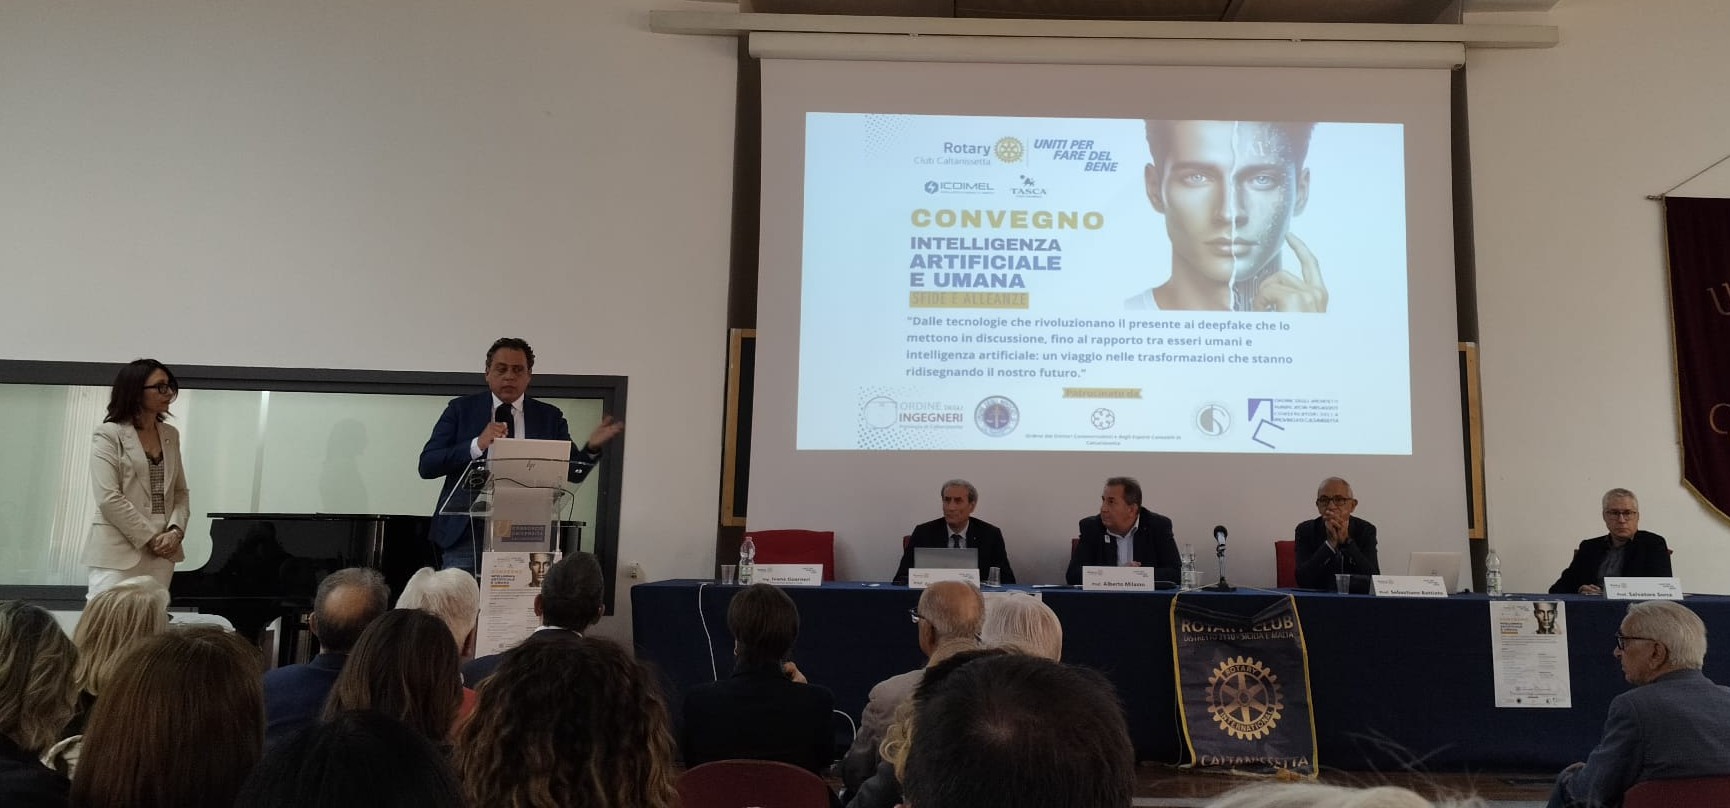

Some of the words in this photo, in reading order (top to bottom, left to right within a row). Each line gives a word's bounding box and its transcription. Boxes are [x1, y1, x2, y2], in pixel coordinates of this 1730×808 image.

[944, 142, 991, 157] Rotary
[1033, 139, 1067, 150] UNITI
[1070, 140, 1094, 150] PER
[913, 156, 935, 165] Club
[937, 156, 991, 166] Caltanissetta
[1053, 150, 1085, 161] FARE
[1088, 151, 1112, 161] DEL
[1084, 162, 1118, 172] BENE
[911, 208, 1105, 230] CONVEGNO
[910, 236, 1062, 252] INTELLIGENZA
[910, 254, 1062, 271] ARTIFICIALE
[910, 272, 925, 287] E
[934, 273, 1026, 288] UMANA
[912, 292, 945, 305] SFIDE
[952, 293, 958, 305] E
[963, 292, 1026, 306] ALLEANZE
[946, 317, 1008, 329] tecnologie
[1010, 318, 1032, 327] che
[1034, 318, 1116, 328] rivoluzionano
[1119, 319, 1125, 328] il
[1129, 320, 1181, 332] presente
[1184, 319, 1194, 329] ai
[1197, 319, 1252, 332] deepfake
[1255, 320, 1277, 331] che
[1280, 321, 1290, 331] lo
[906, 333, 958, 343] mettono
[961, 333, 973, 343] in
[976, 333, 1047, 344] discussione,
[1050, 334, 1074, 344] fino
[1077, 334, 1087, 345] al
[1090, 336, 1143, 347] rapporto
[1146, 336, 1164, 346] tra
[1167, 336, 1202, 346] esseri
[1205, 336, 1242, 347] umani
[1245, 339, 1253, 347] e
[906, 349, 975, 362] intelligenza
[979, 350, 1039, 361] artificiale:
[1042, 352, 1057, 361] un
[1060, 352, 1103, 364] viaggio
[1105, 351, 1134, 362] nelle
[1138, 352, 1225, 363] trasformazioni
[1228, 353, 1249, 364] che
[1252, 354, 1293, 365] stanno
[906, 367, 984, 379] ridisegnando
[987, 367, 994, 377] il
[997, 368, 1037, 377] nostro
[1039, 367, 1086, 378] futuro."
[1126, 388, 1139, 398] da
[900, 402, 942, 411] ORDINE
[899, 413, 964, 422] INGEGNERI
[1252, 616, 1294, 632] CLUB
[1226, 665, 1258, 675] ROTARY
[1219, 708, 1275, 732] INTERNATIONAL
